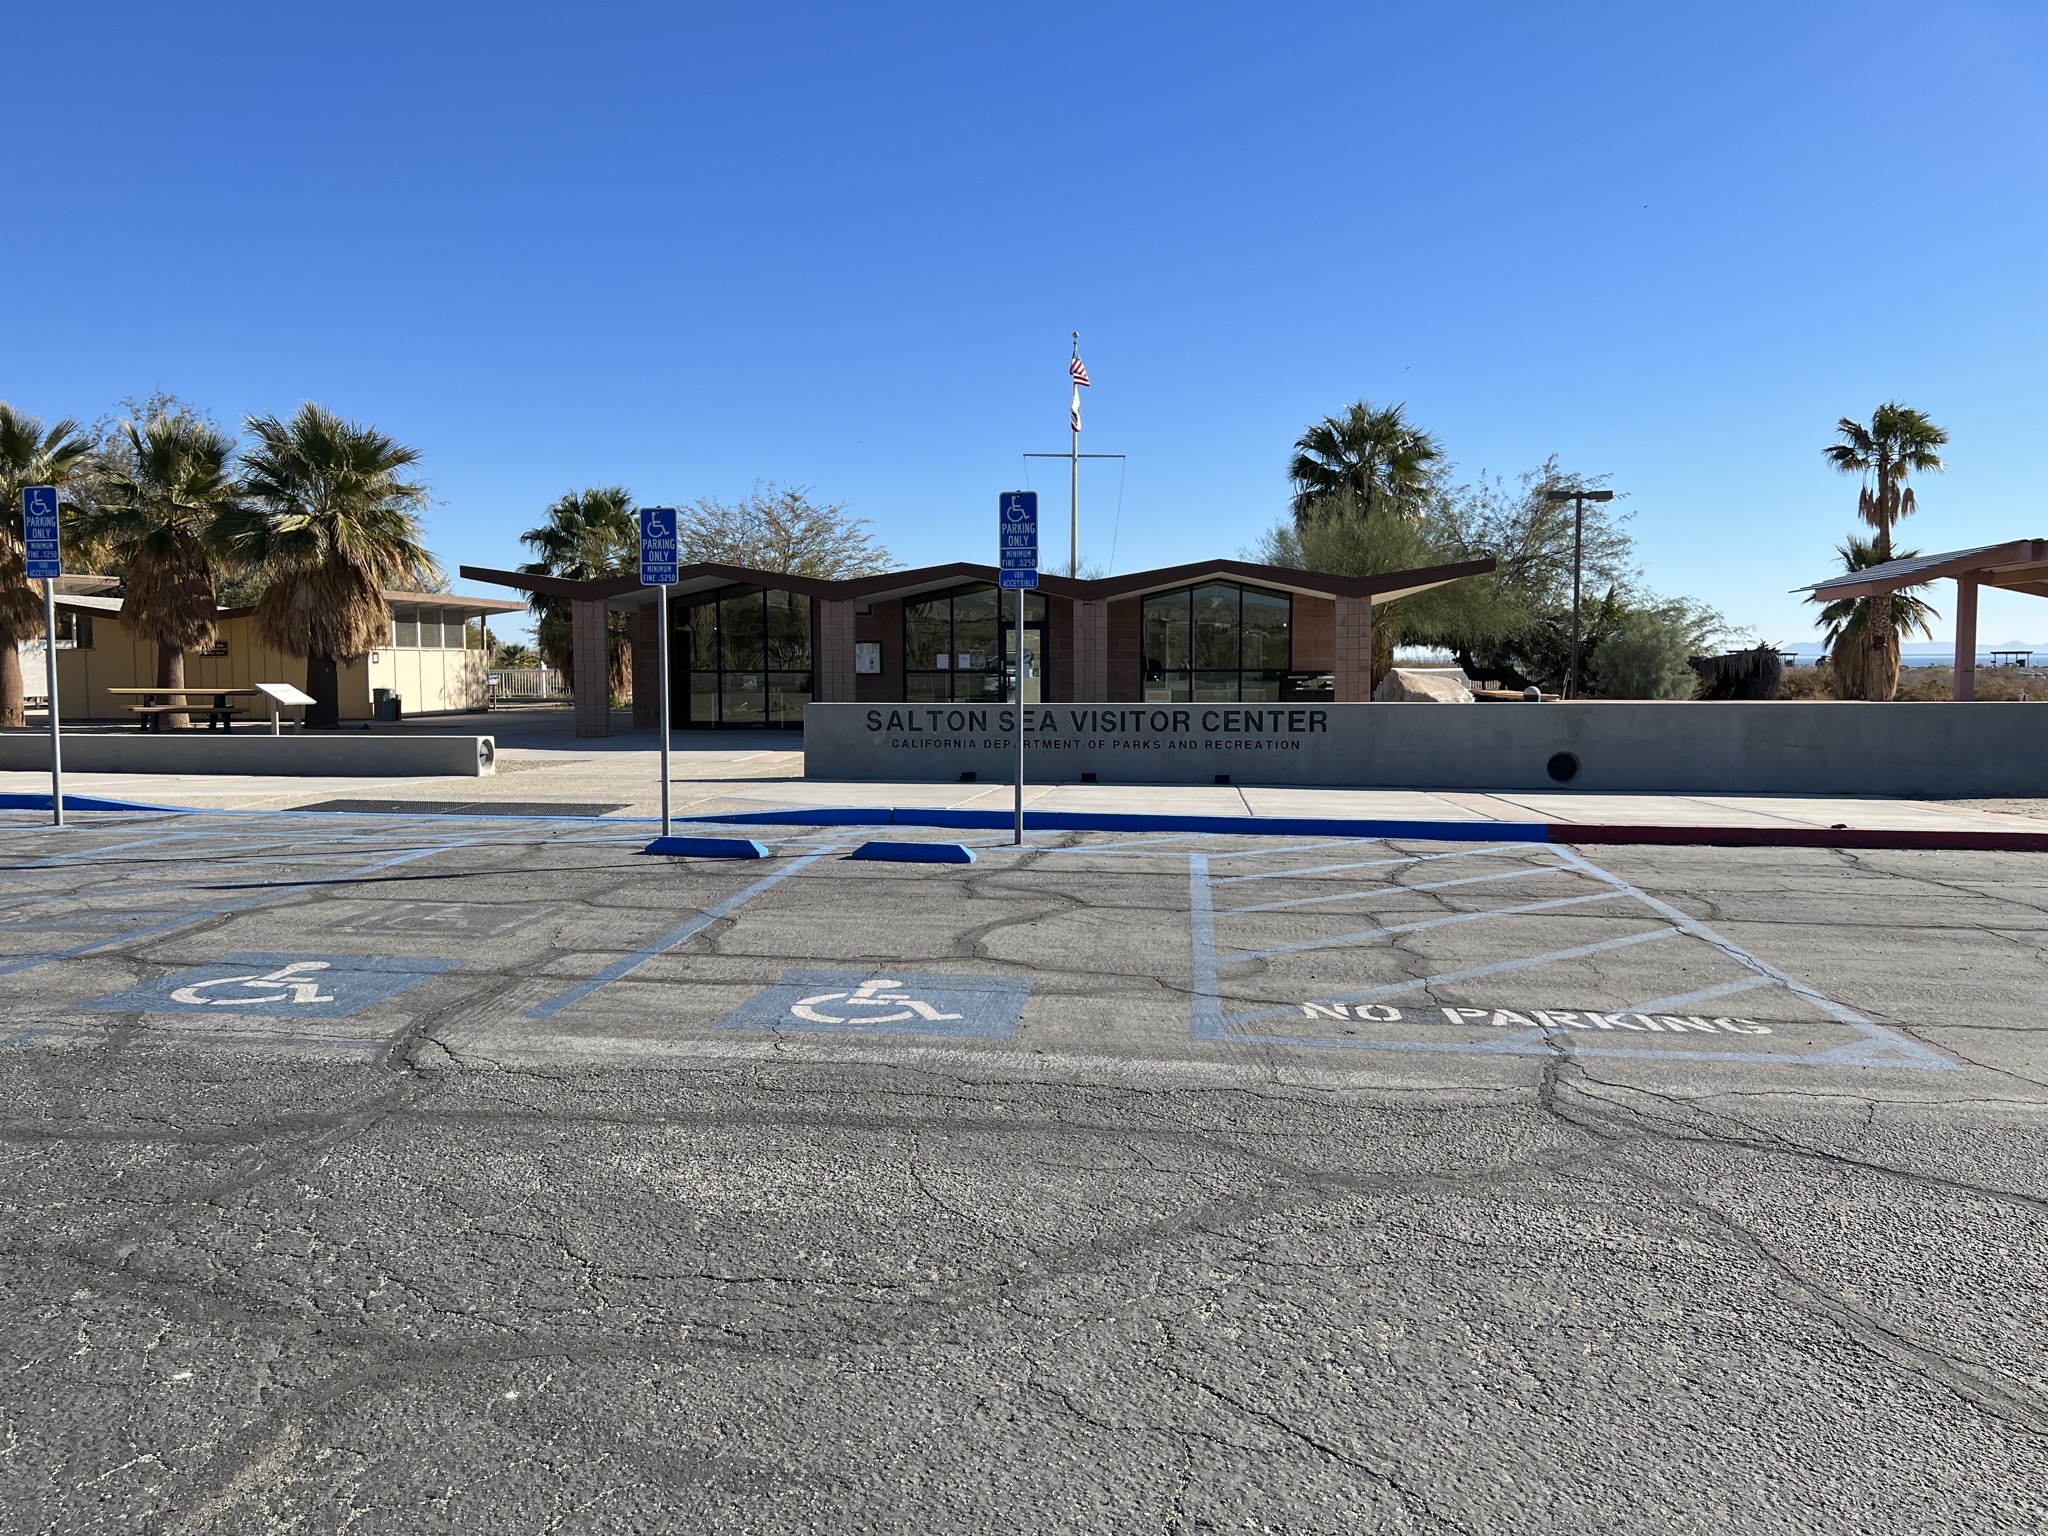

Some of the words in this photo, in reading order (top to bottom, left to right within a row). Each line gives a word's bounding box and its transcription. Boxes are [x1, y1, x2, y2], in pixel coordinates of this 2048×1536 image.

[26, 516, 56, 527] PARKING
[32, 528, 51, 539] ONLY
[1002, 523, 1035, 534] PARKING
[643, 539, 675, 550] PARKING
[1008, 536, 1029, 546] ONLY
[28, 550, 40, 558] FINE
[649, 551, 669, 562] ONLY
[866, 710, 987, 732] SALTON
[999, 710, 1058, 732] SEA
[1070, 710, 1190, 732] VISITOR
[1202, 711, 1328, 732] CENTER
[892, 739, 976, 748] CALIFORNIA
[984, 739, 1080, 749] DEPRTMENT
[1088, 740, 1104, 749] OF
[1113, 740, 1161, 749] PARKS
[1168, 740, 1198, 749] AND
[1205, 740, 1300, 750] RECREATION
[1301, 1002, 1402, 1022] NO
[1441, 1007, 1773, 1036] PARKING
